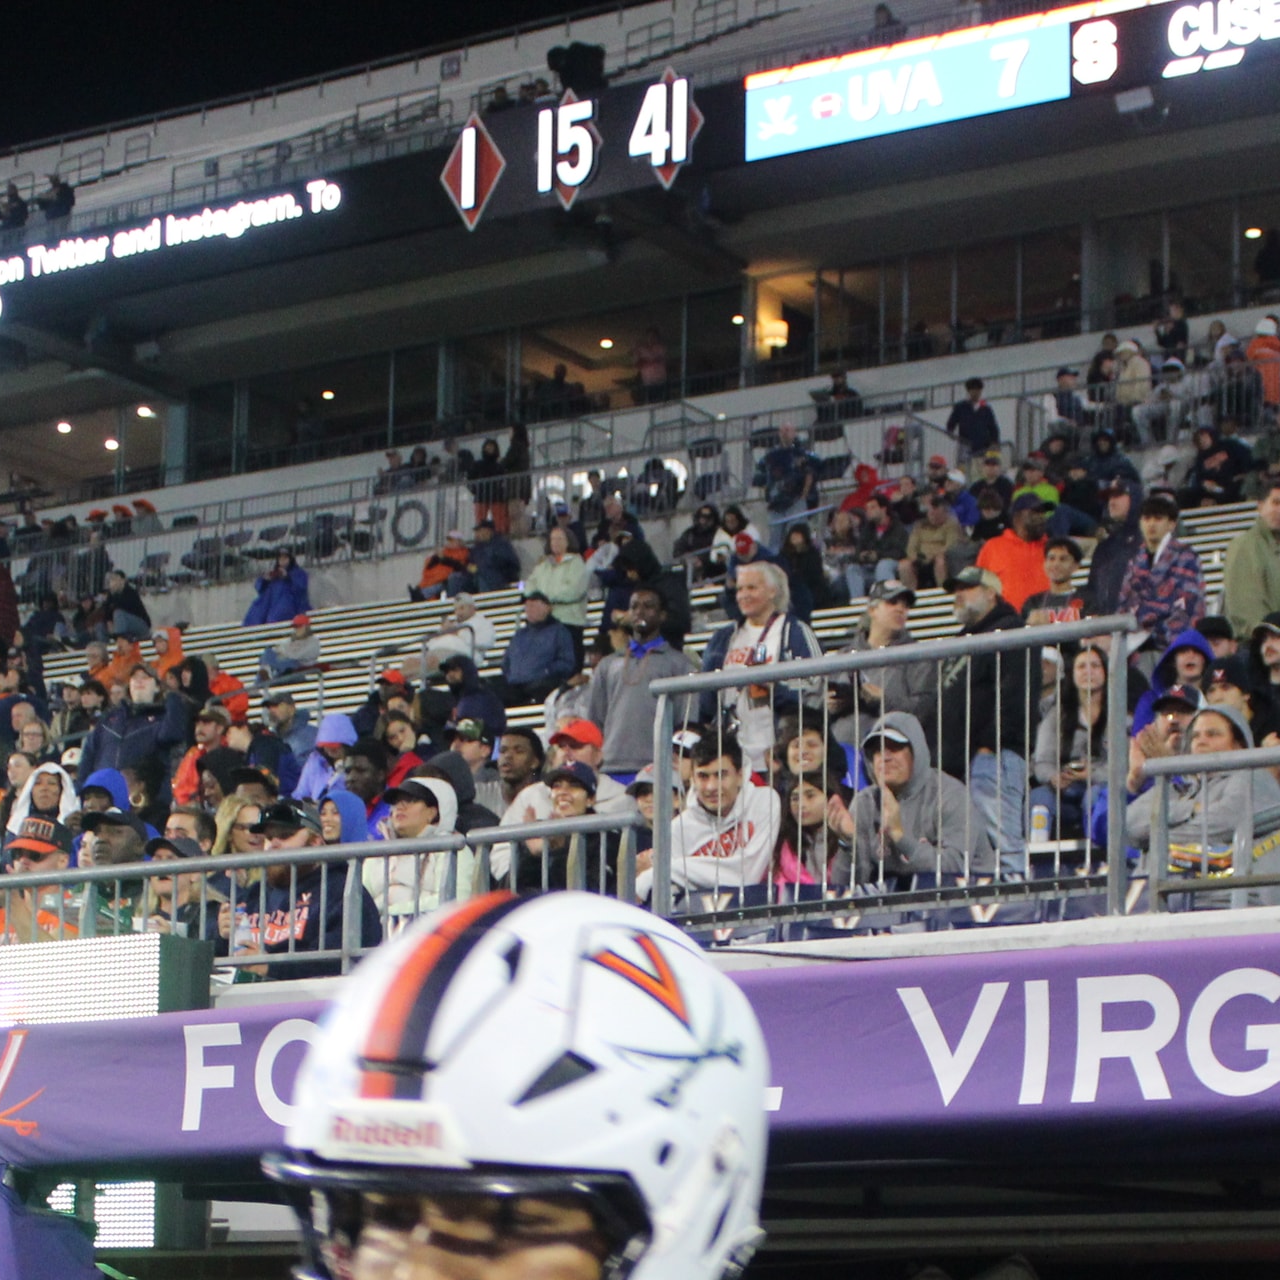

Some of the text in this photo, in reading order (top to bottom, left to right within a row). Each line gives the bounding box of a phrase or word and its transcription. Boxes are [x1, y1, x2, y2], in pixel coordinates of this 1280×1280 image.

[849, 38, 1030, 121] UVA 7
[461, 78, 688, 209] 1 15 41
[28, 236, 109, 277] Twitter
[113, 219, 161, 258] and
[167, 193, 302, 246] Instagram.
[307, 180, 341, 212] To
